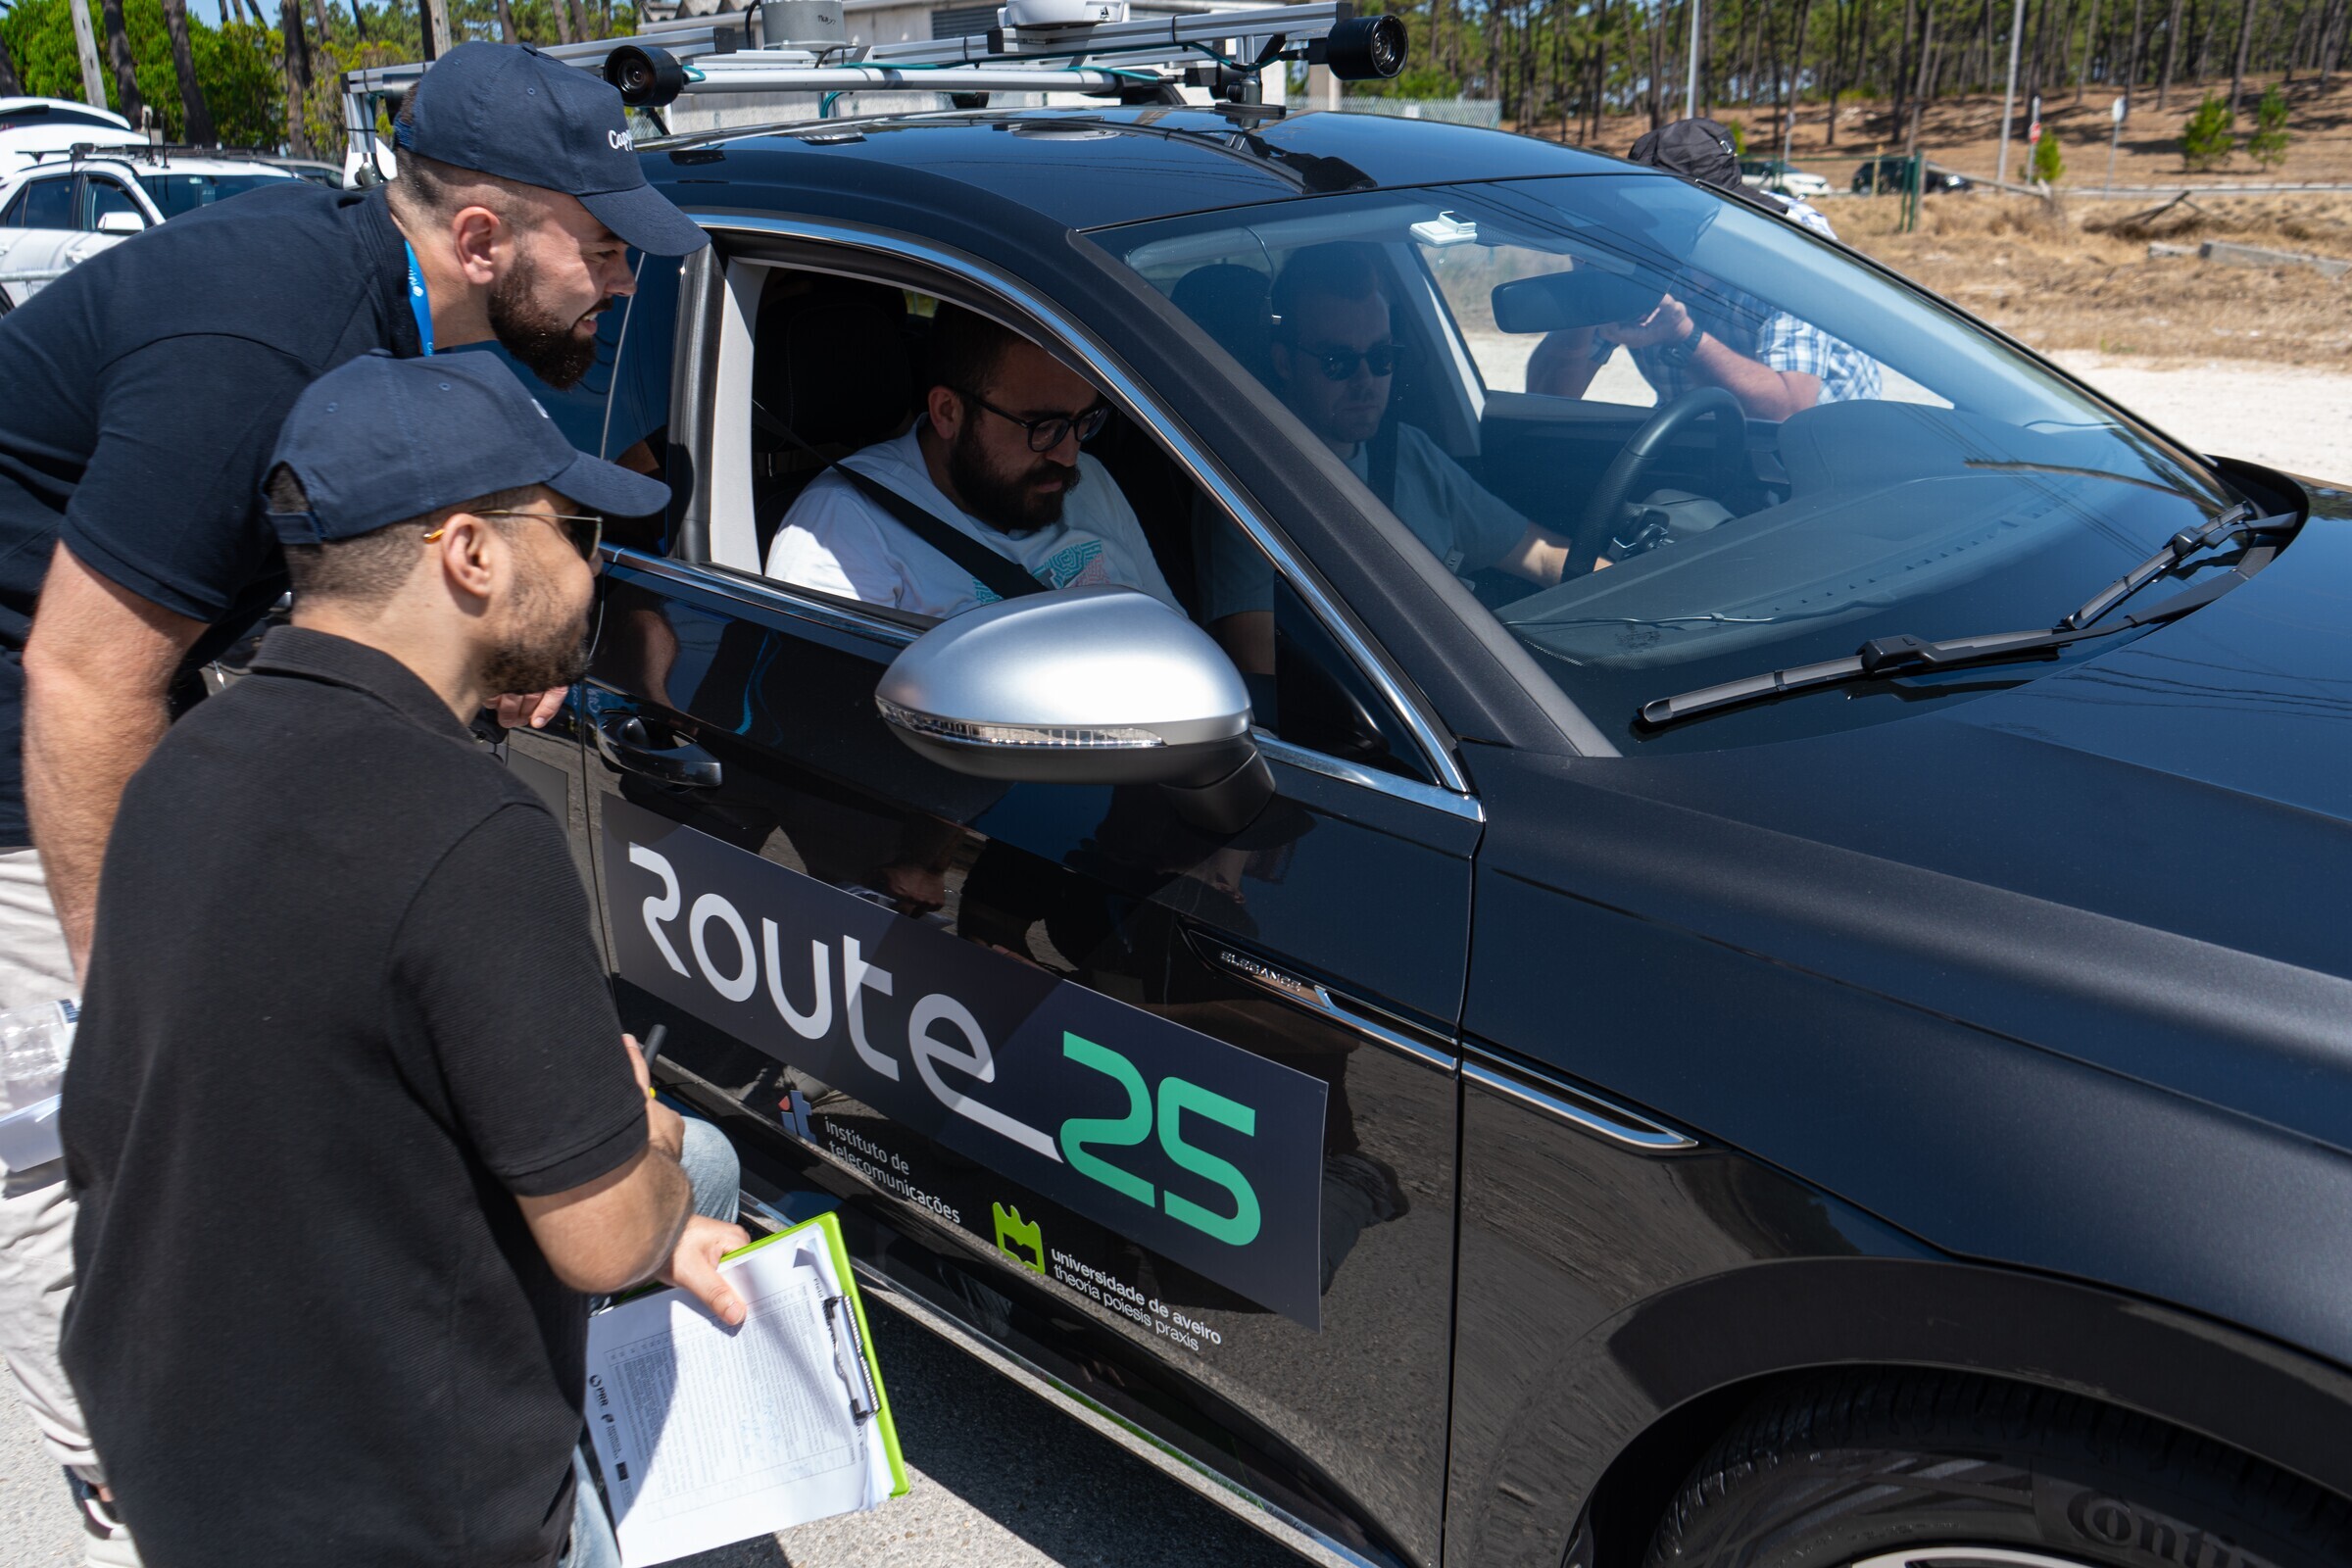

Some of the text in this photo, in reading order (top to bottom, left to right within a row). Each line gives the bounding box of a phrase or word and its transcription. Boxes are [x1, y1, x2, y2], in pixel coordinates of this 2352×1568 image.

[824, 1116, 909, 1175] instituto de
[829, 1140, 960, 1224] telecomunicações
[1051, 1249, 1222, 1345] universidade de aveiro
[1054, 1264, 1199, 1351] theoria poiesis praxis
[2066, 1487, 2256, 1568] Conti
